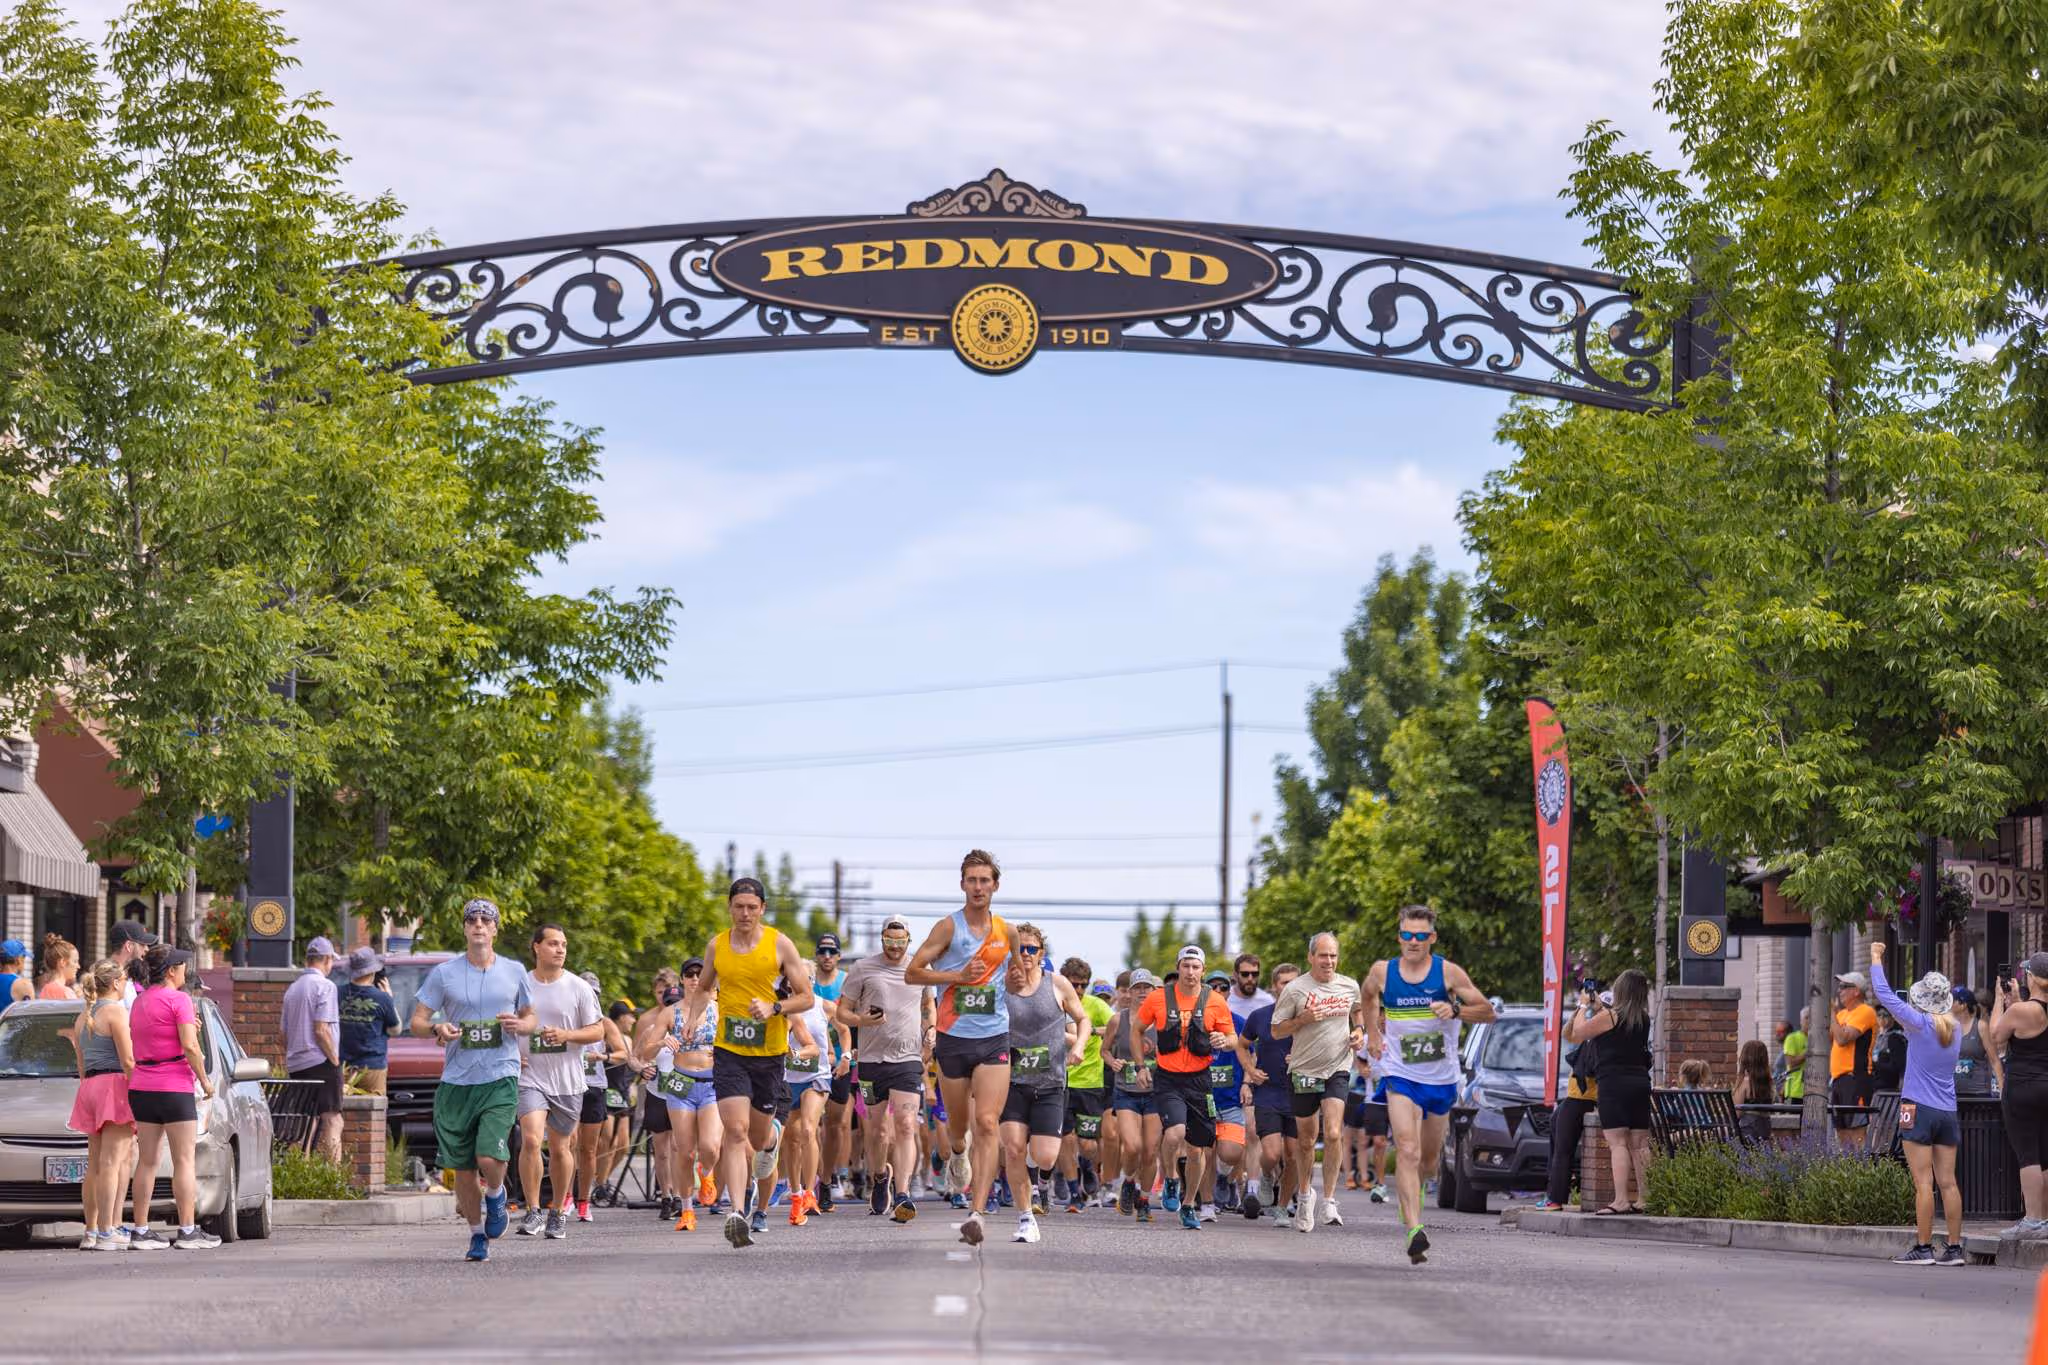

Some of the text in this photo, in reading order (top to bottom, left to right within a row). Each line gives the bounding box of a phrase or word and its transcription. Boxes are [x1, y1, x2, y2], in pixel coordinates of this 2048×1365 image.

[761, 238, 1229, 286] REDMOND
[882, 326, 1110, 344] EST 1910
[964, 994, 987, 1008] 84
[1397, 998, 1433, 1006] BOSTON
[470, 1029, 492, 1042] 95
[734, 1025, 756, 1040] 50
[1411, 1042, 1435, 1056] 74
[1020, 1056, 1040, 1068] 47
[1211, 1072, 1227, 1083] 52
[668, 1078, 684, 1092] 48
[1081, 1121, 1097, 1132] 34
